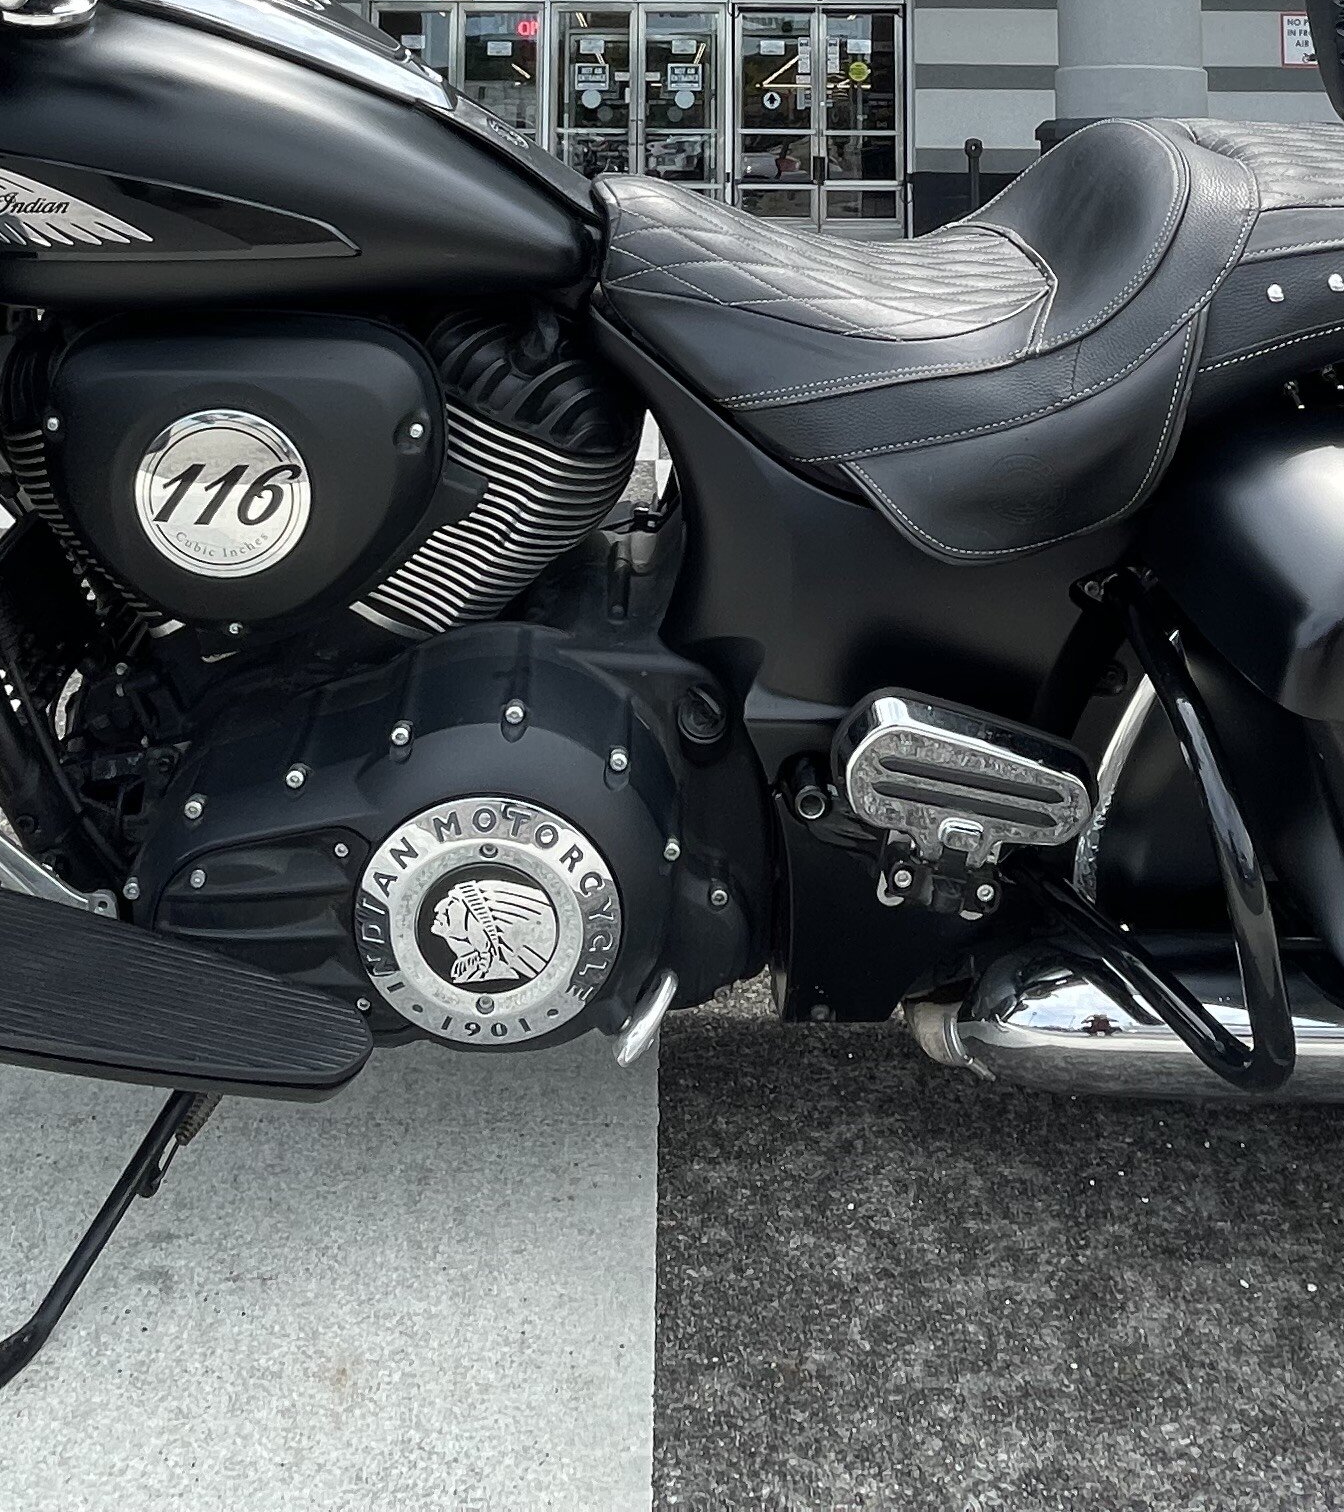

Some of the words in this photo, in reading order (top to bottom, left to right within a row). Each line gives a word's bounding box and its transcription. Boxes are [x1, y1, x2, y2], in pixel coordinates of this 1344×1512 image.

[153, 463, 303, 526] 116
[175, 531, 215, 558] Cubic
[223, 532, 270, 558] Inches
[362, 836, 419, 994] INDIAN
[432, 807, 615, 1001] MOTORCYCLE
[440, 1014, 532, 1038] 1901
